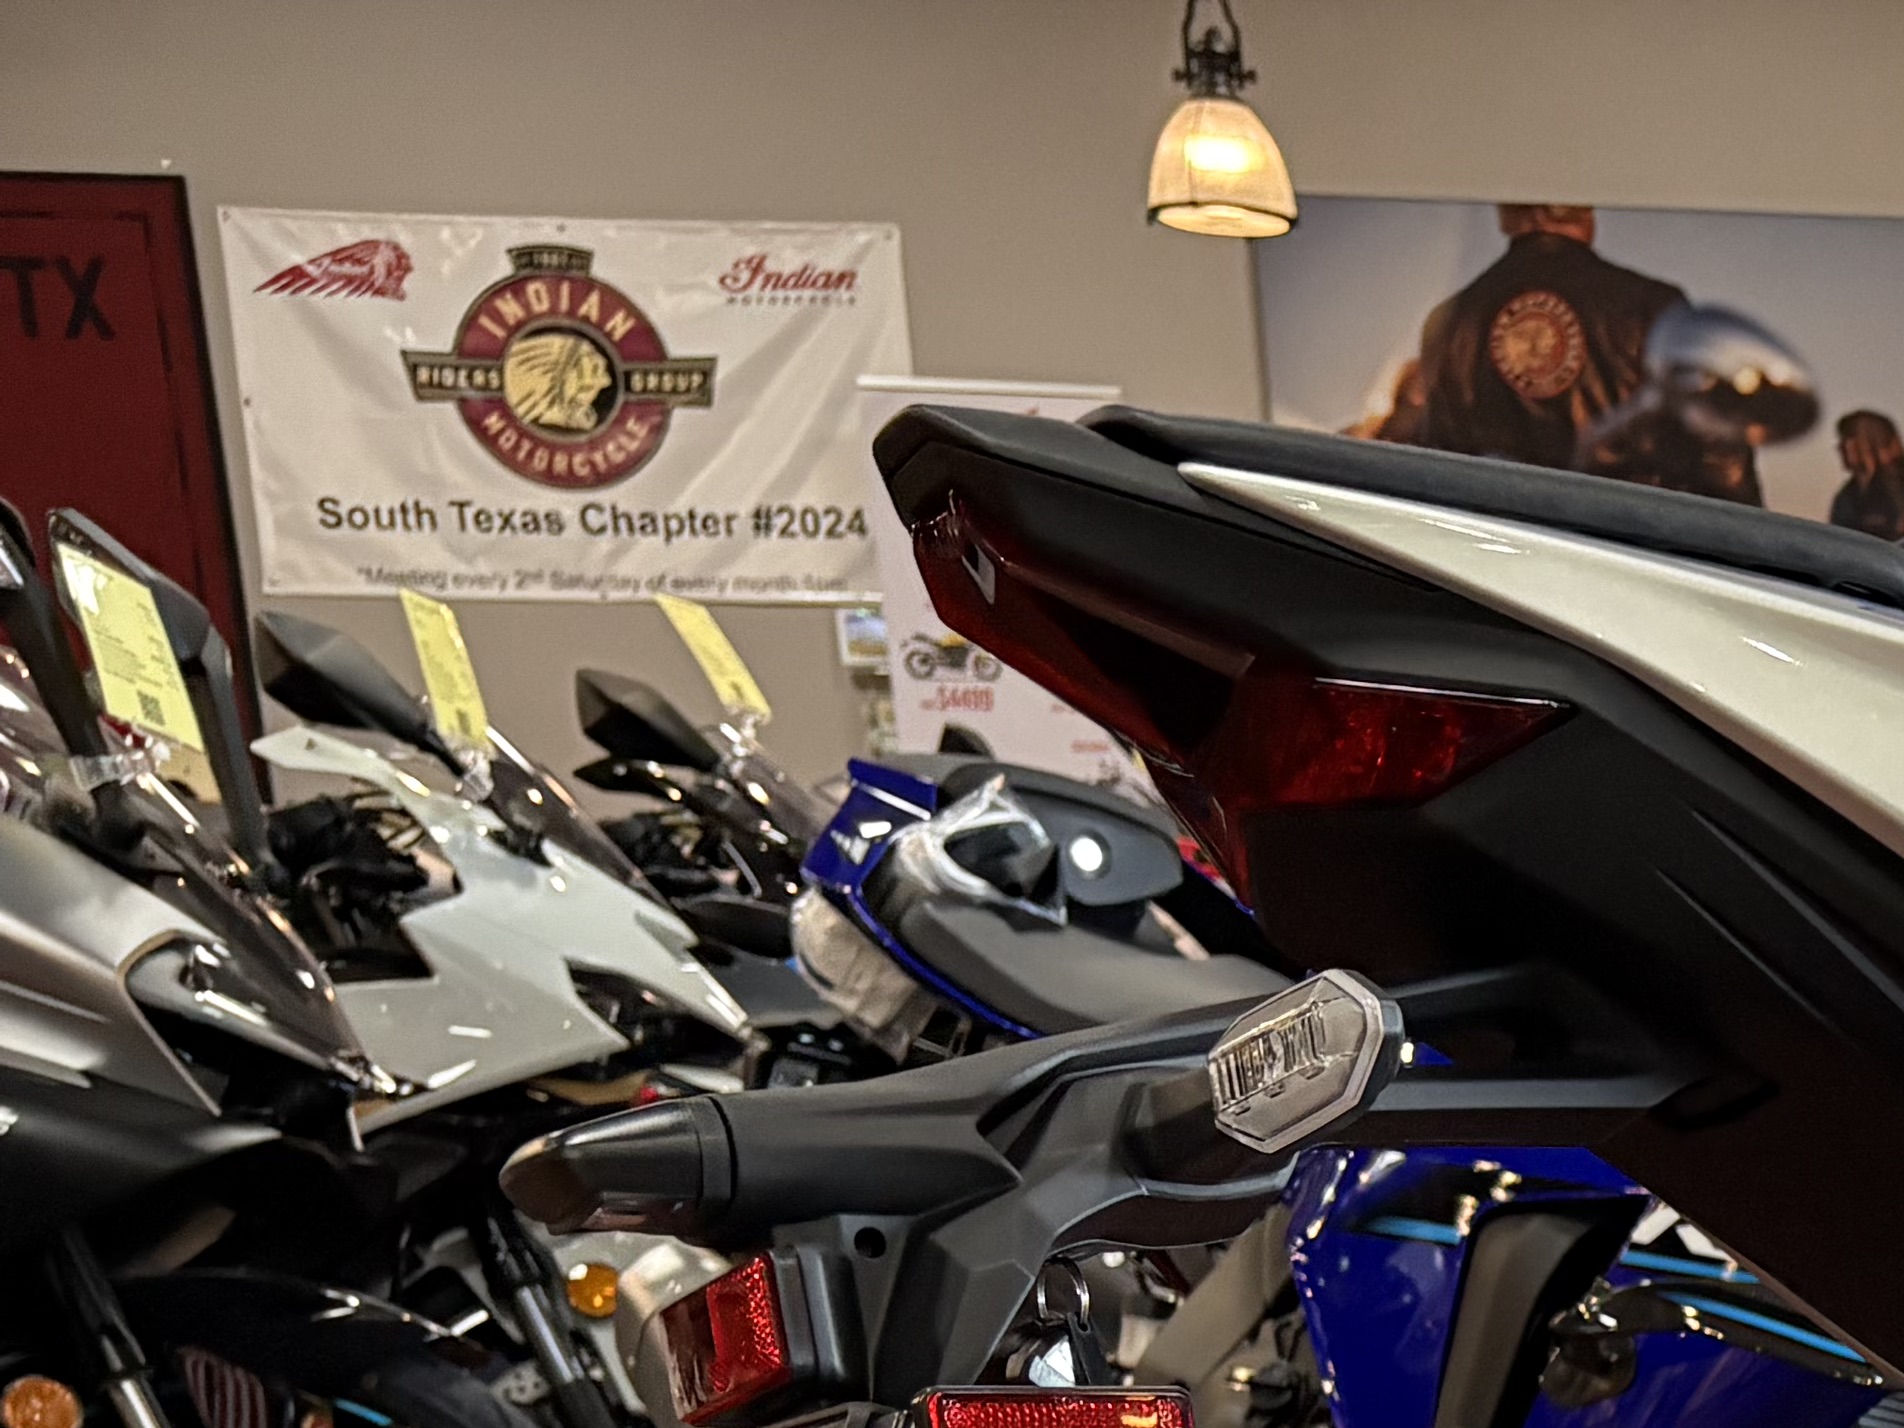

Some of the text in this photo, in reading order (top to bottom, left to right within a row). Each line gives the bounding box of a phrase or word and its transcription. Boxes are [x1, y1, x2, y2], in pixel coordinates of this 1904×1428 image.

[718, 253, 858, 294] Indian
[478, 281, 636, 341] INDIAN
[415, 365, 501, 384] RIDERS
[630, 371, 705, 393] GROUP
[482, 411, 650, 477] MOTORCYCLE
[318, 496, 869, 543] South Texas Chapter #2024
